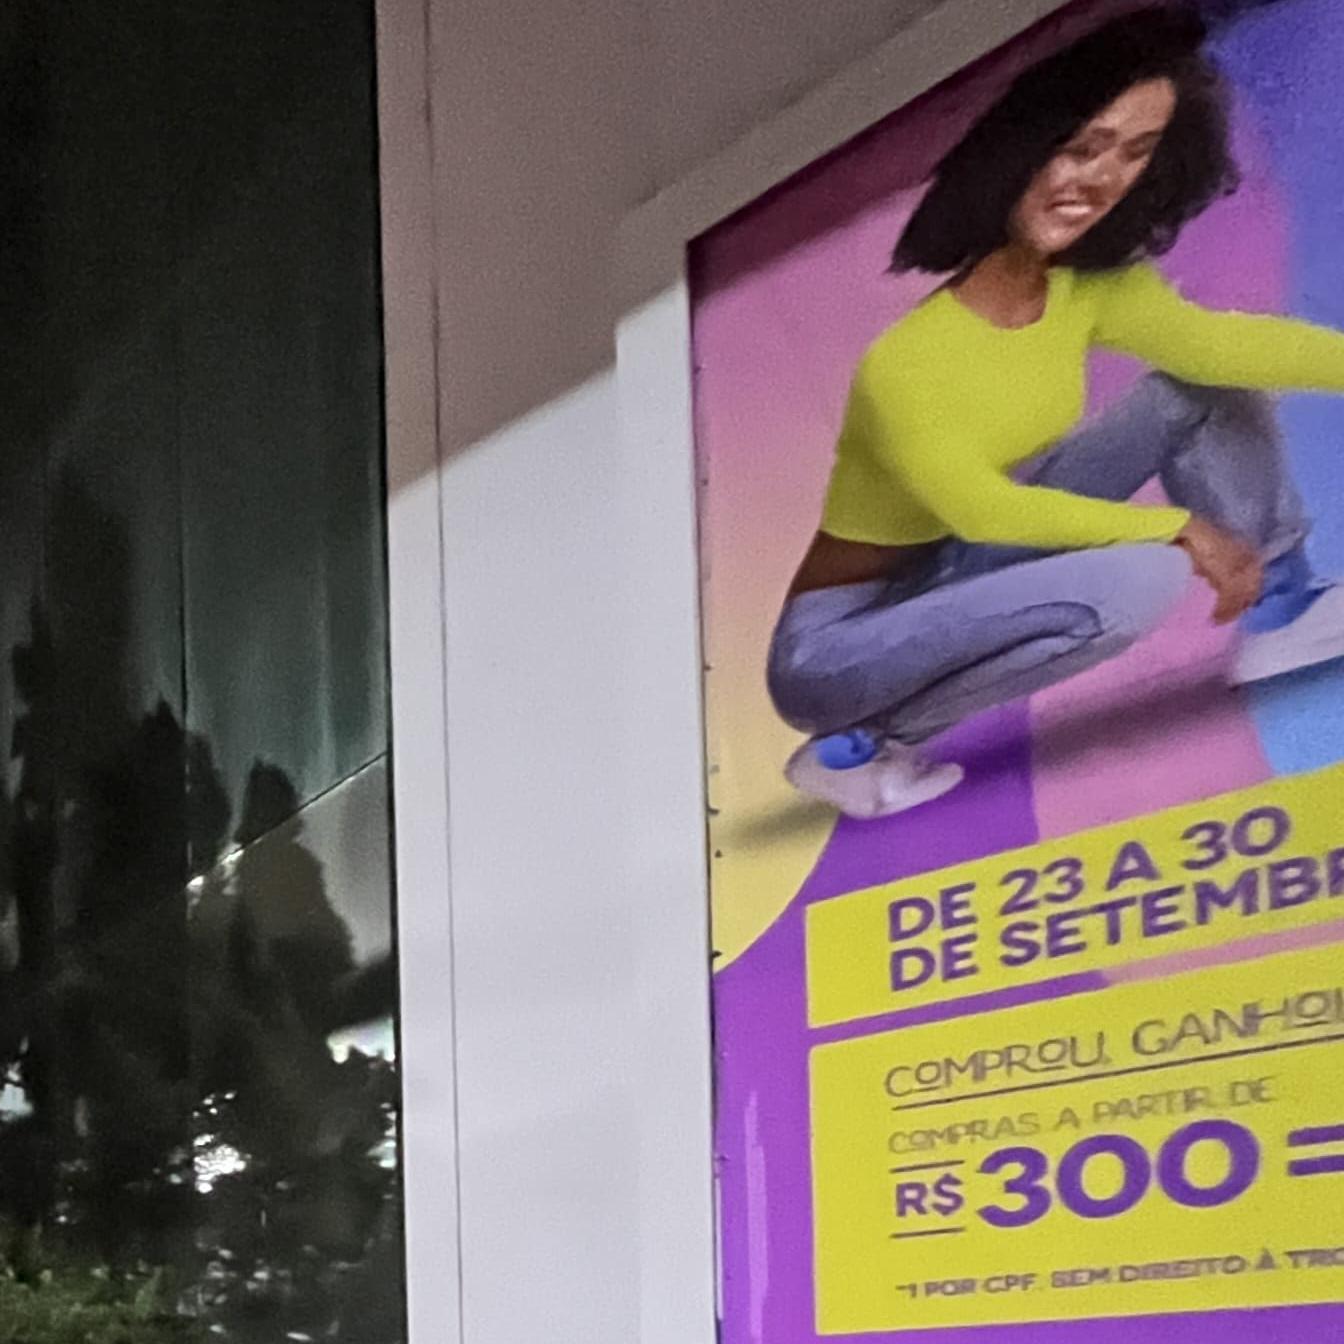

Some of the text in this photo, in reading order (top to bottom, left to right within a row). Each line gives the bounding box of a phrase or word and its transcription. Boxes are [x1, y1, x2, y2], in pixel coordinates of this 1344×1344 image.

[887, 805, 1292, 942] DE 23 A 30
[888, 932, 979, 993] DE
[1131, 987, 1344, 1057] GANHO
[888, 1075, 1278, 1155] COMPRAS A PARTIR DE
[894, 1172, 966, 1219] R$
[975, 1118, 1262, 1229] 300
